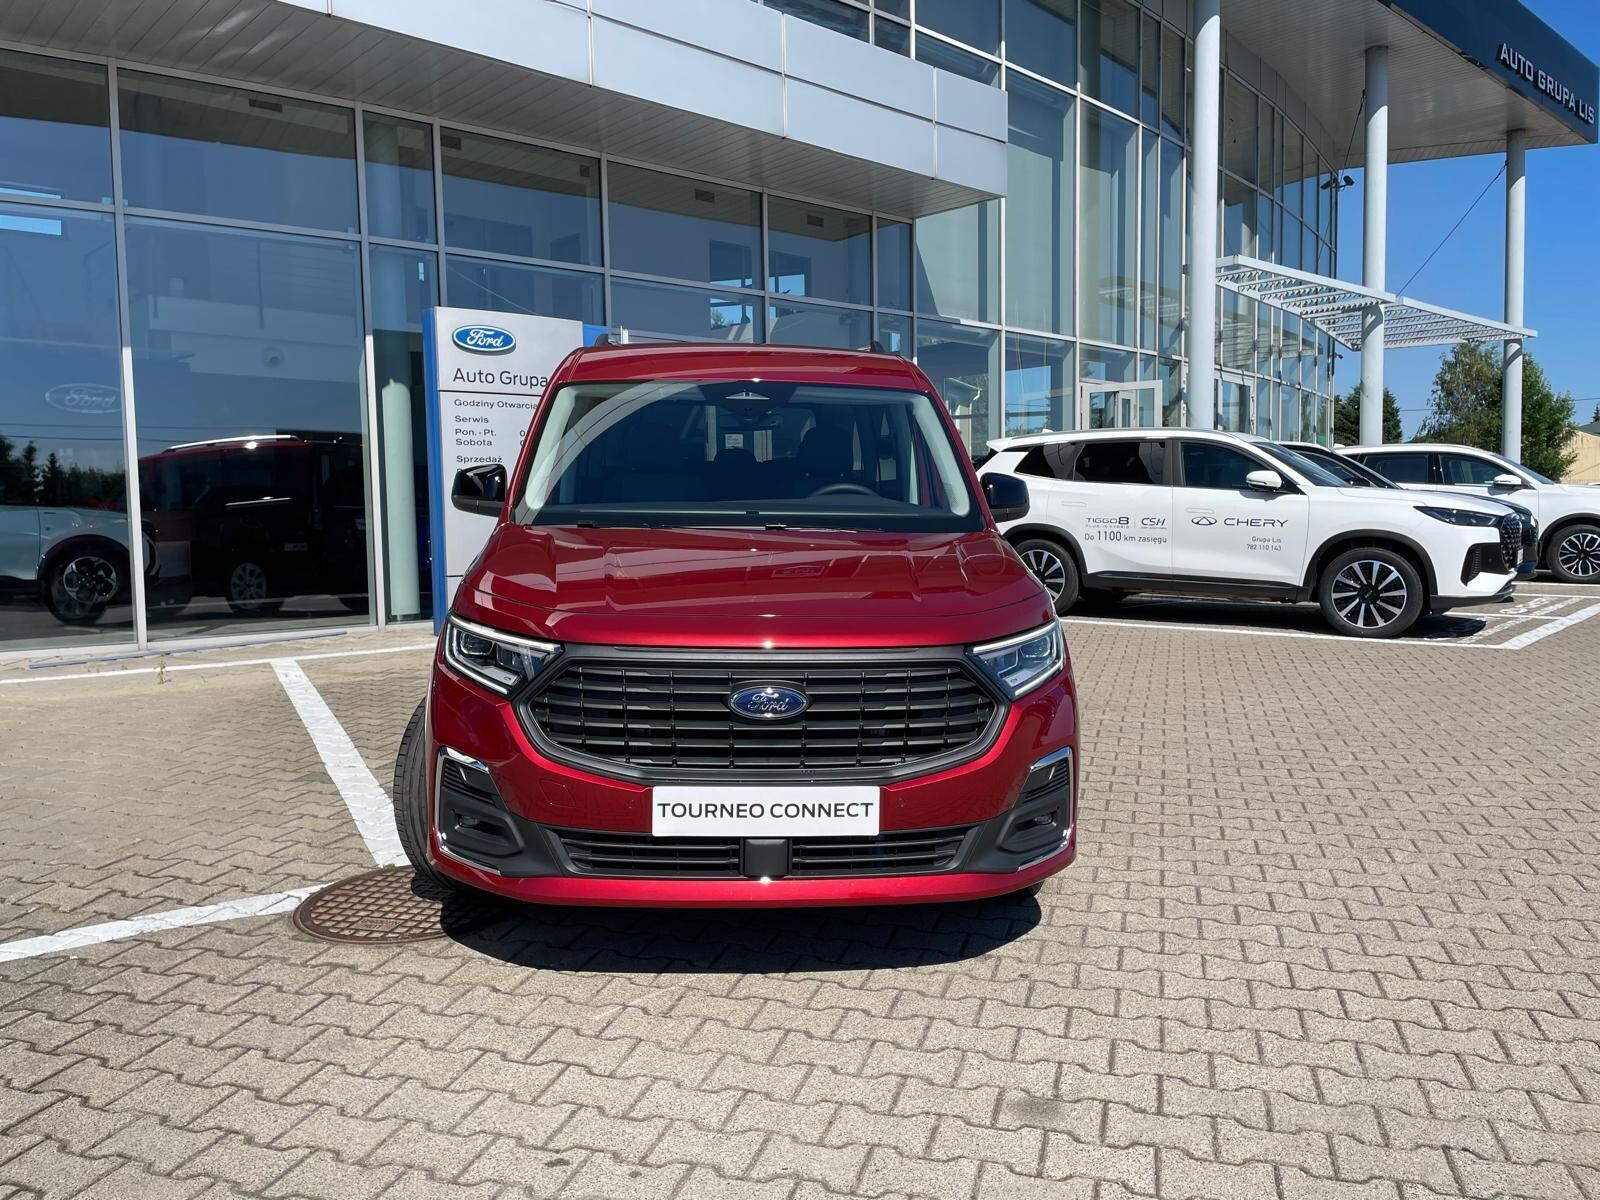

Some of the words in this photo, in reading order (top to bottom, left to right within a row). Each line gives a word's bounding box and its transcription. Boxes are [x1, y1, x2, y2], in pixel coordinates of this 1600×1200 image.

[1500, 43, 1534, 82] AUTO
[1538, 69, 1576, 112] GRUPA
[1579, 99, 1595, 125] LIS
[453, 367, 495, 384] Auto
[500, 371, 548, 389] Grupa
[454, 398, 495, 409] Godziny
[455, 415, 489, 424] Serwis
[456, 438, 493, 447] Sobota
[456, 455, 503, 464] Sprzedaż
[1224, 517, 1289, 528] CHERY
[1084, 532, 1095, 541] Do
[1098, 530, 1122, 542] 1100
[1123, 534, 1136, 542] km
[1137, 535, 1168, 545] zasięgu
[1251, 535, 1271, 544] Grupa
[1272, 536, 1282, 544] Lis
[1259, 543, 1270, 551] 110
[656, 802, 766, 819] TOURNEO
[769, 802, 874, 819] CONNECT
